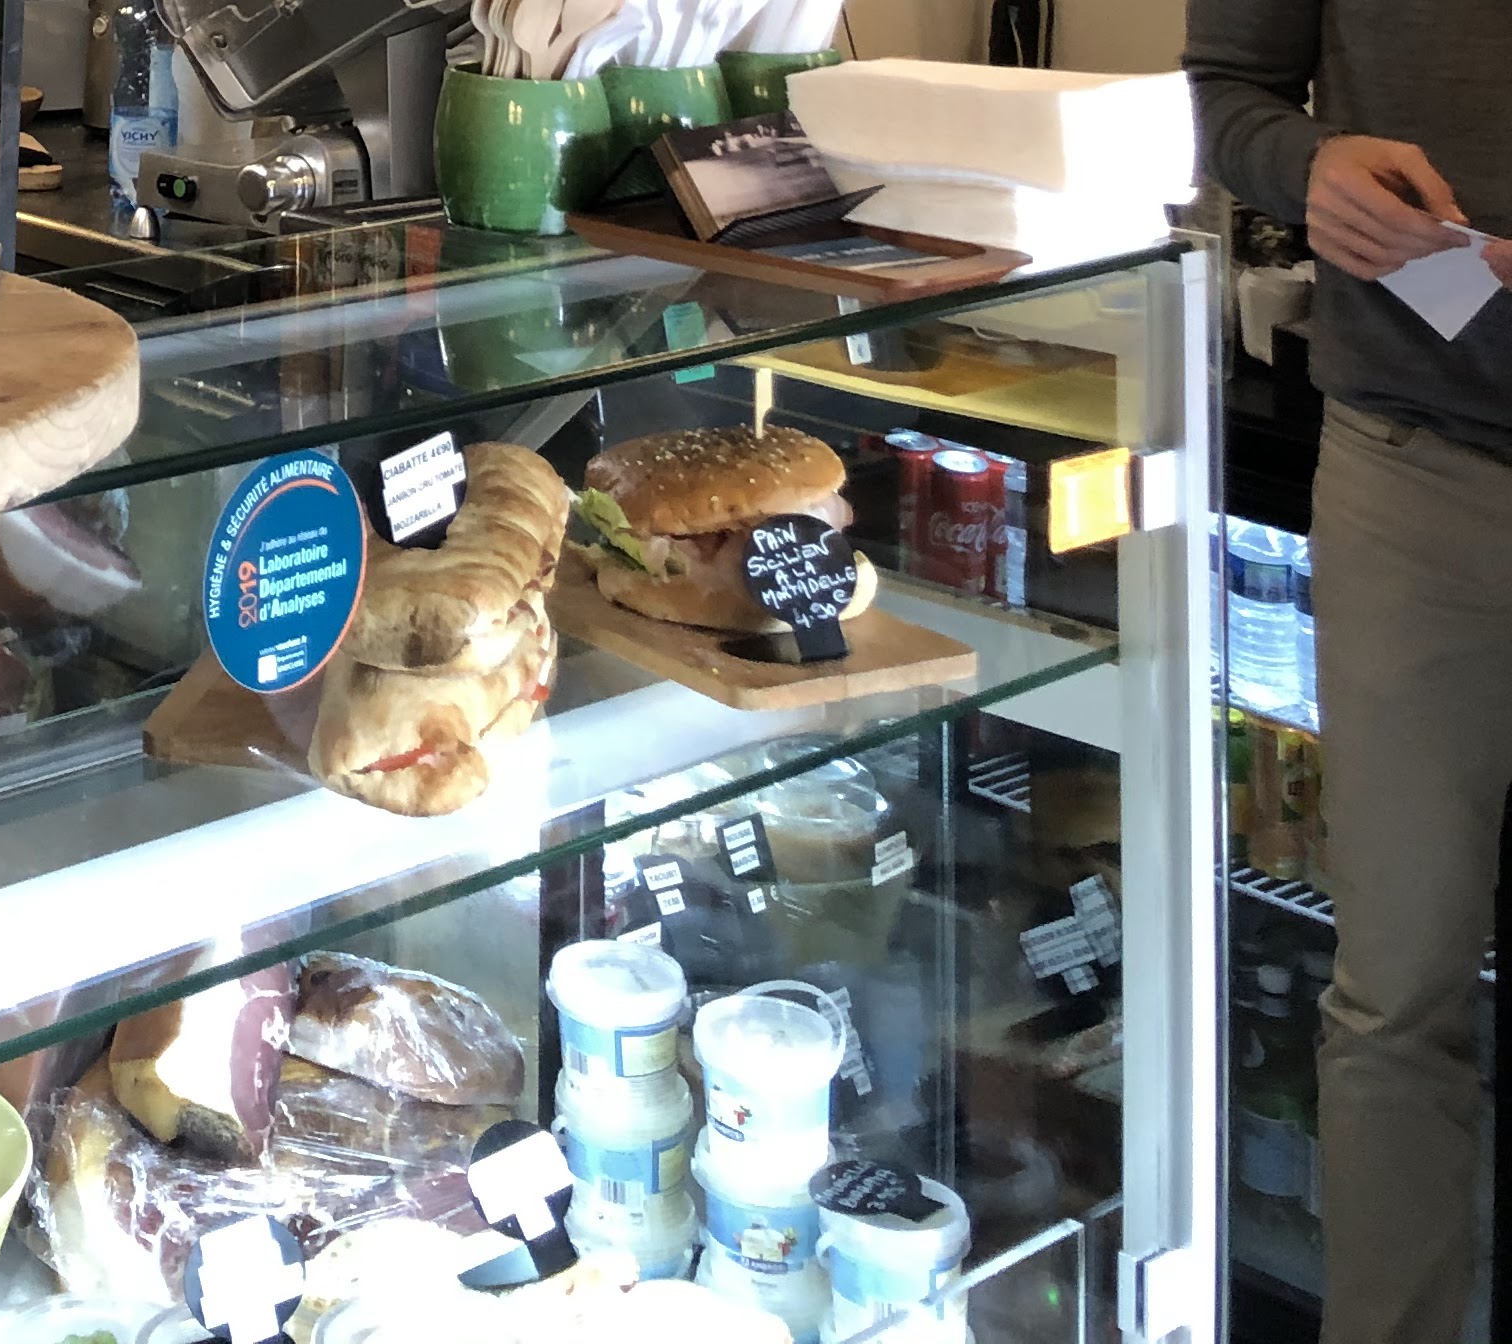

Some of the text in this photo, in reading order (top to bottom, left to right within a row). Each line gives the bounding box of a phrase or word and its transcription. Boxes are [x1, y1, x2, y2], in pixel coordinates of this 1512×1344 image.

[121, 129, 159, 141] VICHY
[269, 459, 335, 487] ALIMENTAIRE
[383, 451, 428, 481] CIABATTE
[259, 543, 328, 575] Laboratoire
[259, 557, 347, 599] Départemental
[259, 590, 326, 622] d'Analyses
